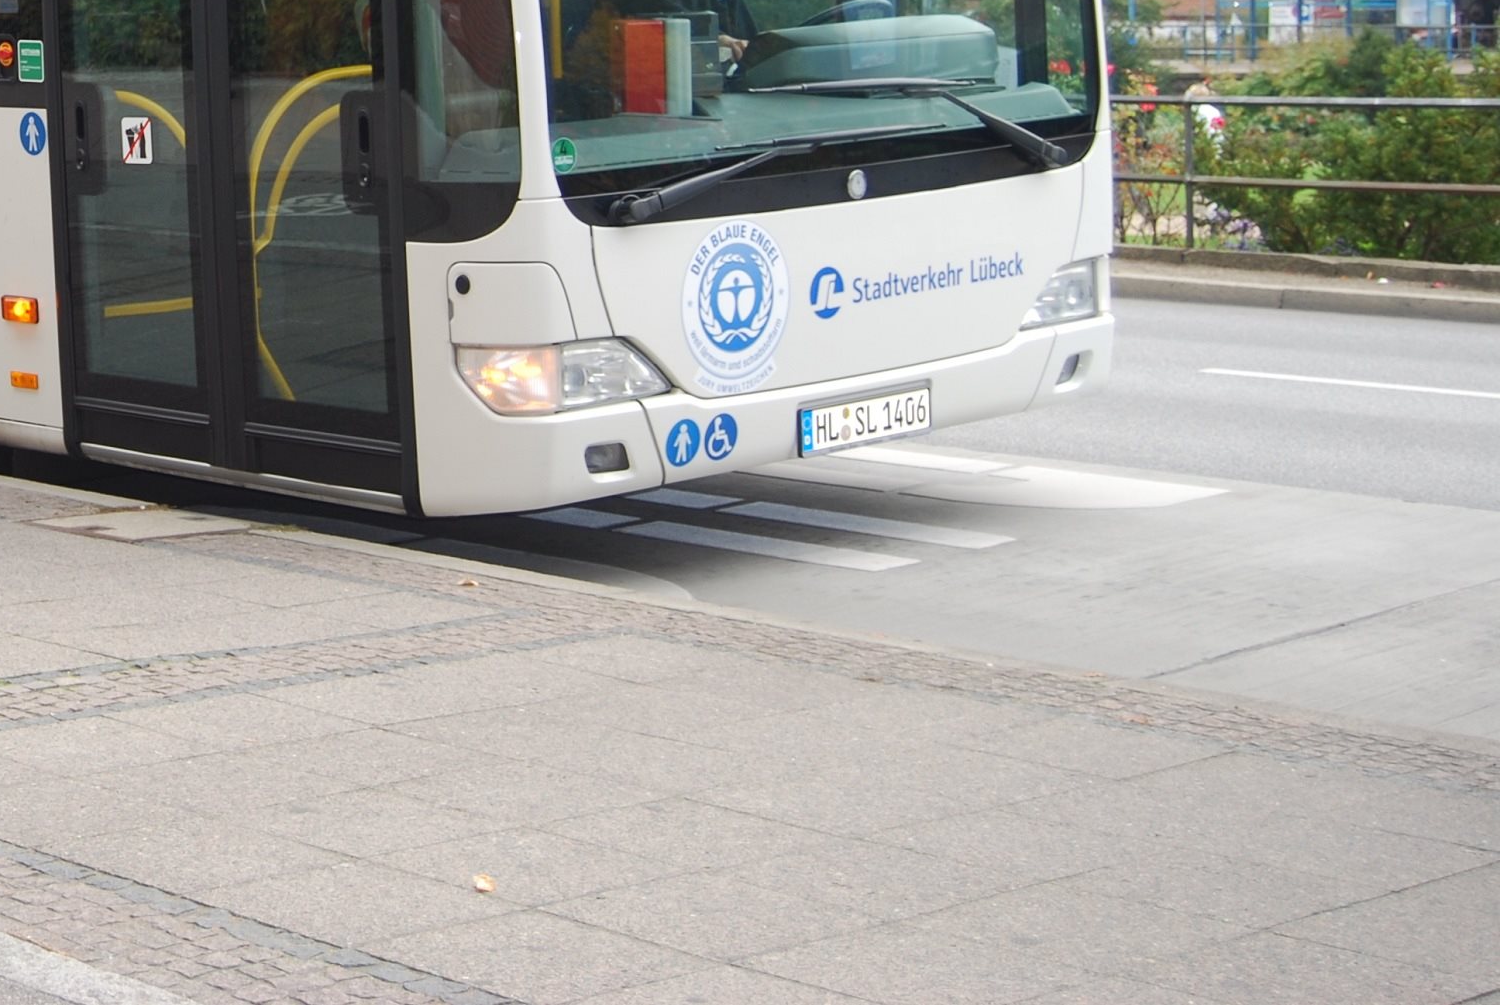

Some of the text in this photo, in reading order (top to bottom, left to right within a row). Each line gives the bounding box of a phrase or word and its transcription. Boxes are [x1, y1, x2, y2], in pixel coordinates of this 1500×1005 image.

[690, 224, 781, 276] DER BLAUE ENGEL
[852, 251, 1024, 304] Stadtverkehr Lübeck
[816, 394, 926, 444] HL SL 1406
